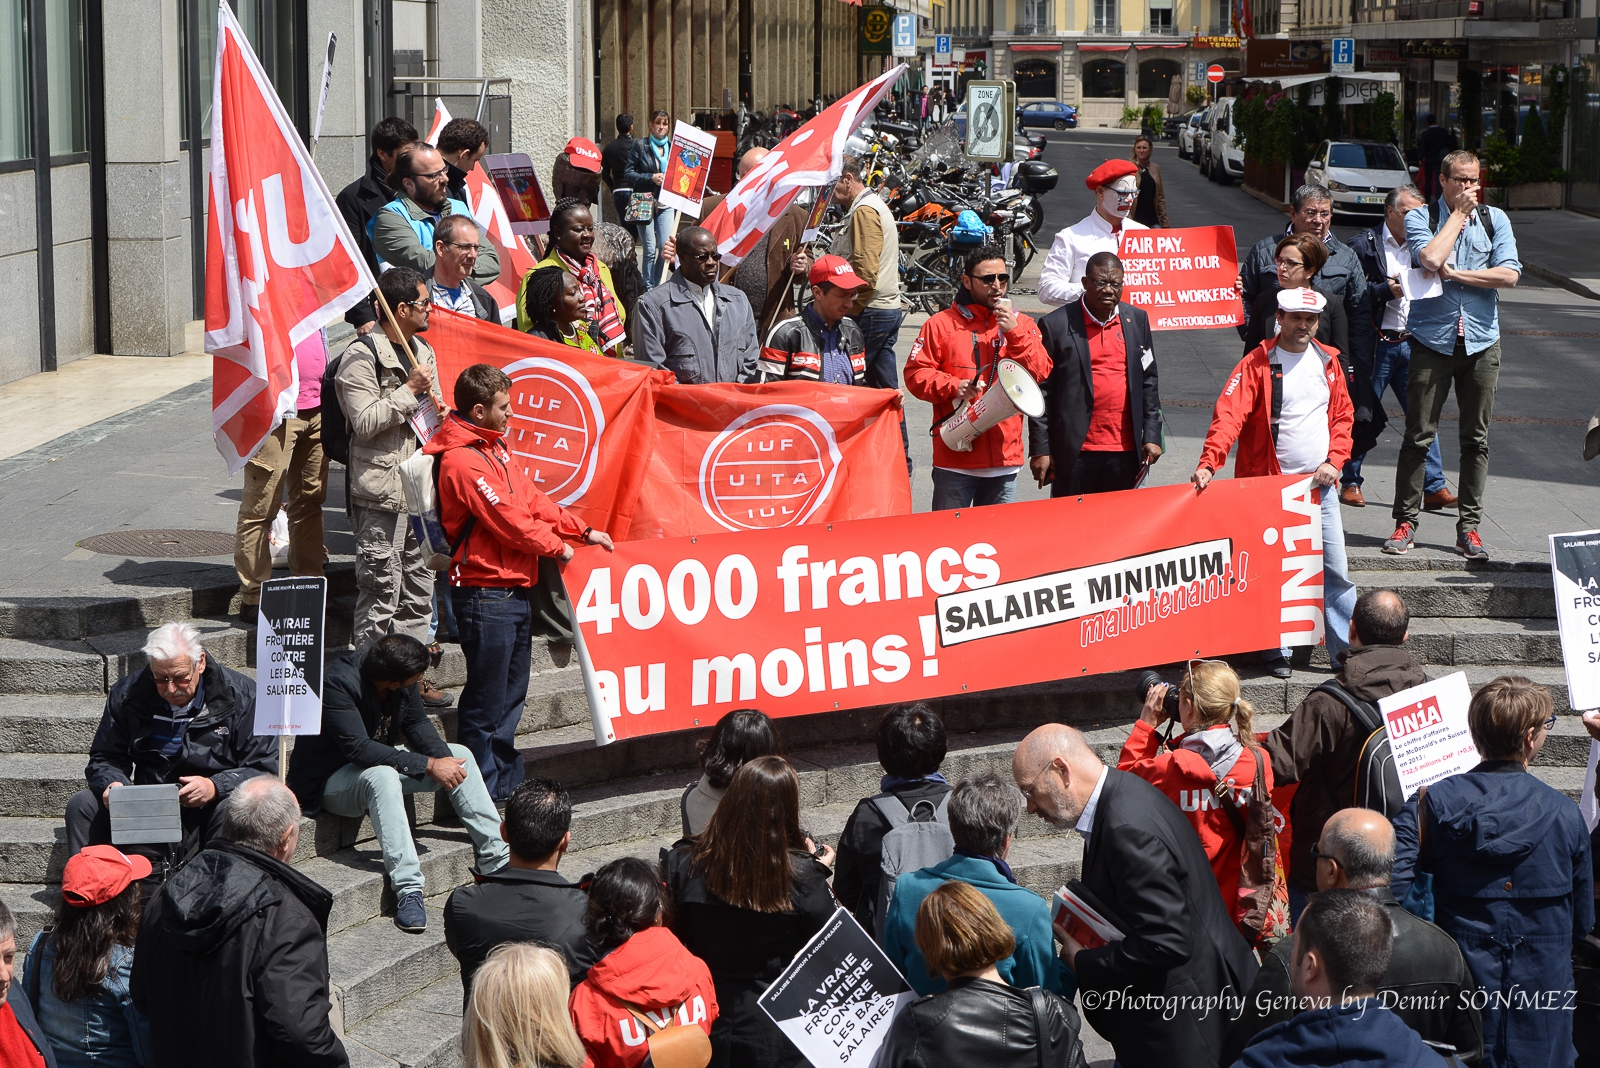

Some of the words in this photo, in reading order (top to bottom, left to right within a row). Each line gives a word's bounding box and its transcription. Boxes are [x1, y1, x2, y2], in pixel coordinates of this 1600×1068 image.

[899, 16, 910, 32] P
[1340, 41, 1348, 53] P
[977, 90, 993, 99] ZONE
[1124, 237, 1154, 254] FAIR
[1156, 237, 1186, 253] PAY.
[1120, 258, 1166, 272] RESPECT
[1169, 257, 1193, 271] FOR
[1194, 255, 1220, 270] OUR
[1122, 272, 1164, 286] RIGHTS.
[1129, 291, 1153, 305] FOR
[1154, 290, 1176, 305] ALL
[1176, 287, 1240, 303] WORKERS.
[1156, 314, 1239, 328] #FASTFOODGLOBAL
[517, 392, 562, 411] IUF
[747, 439, 794, 453] IUF
[729, 473, 808, 487] UITA
[748, 505, 795, 519] IUL
[1562, 541, 1586, 549] SALAIRE
[575, 553, 759, 635] 4000
[776, 542, 1001, 613] francs
[1577, 576, 1599, 590] LA
[945, 582, 1076, 634] SALAIRE
[1087, 551, 1224, 605] MINIMUM
[270, 618, 281, 630] LA
[1587, 614, 1600, 626] C
[1590, 632, 1600, 645] L
[270, 668, 283, 680] LES
[283, 667, 305, 679] BAS
[266, 684, 307, 696] SALAIRES
[594, 662, 666, 720] au
[1394, 743, 1403, 751] Le
[1403, 735, 1422, 749] chiffre
[1422, 726, 1450, 740] d'affaires
[1397, 752, 1405, 760] de
[1405, 739, 1438, 756] McDonald's
[1447, 729, 1468, 741] Suisse
[1401, 765, 1419, 777] 732,5
[1419, 756, 1442, 770] millions
[1442, 752, 1454, 761] CHF
[1408, 754, 1423, 765] 2013
[1405, 768, 1453, 790] Investissements
[1453, 765, 1462, 773] en
[770, 978, 791, 1002] SALAIRE
[789, 957, 809, 982] MINIMUM
[811, 939, 826, 955] 4000
[823, 919, 843, 942] FRANCS
[798, 997, 819, 1018] LA
[816, 952, 858, 995] VRAIE
[804, 957, 874, 1036] FRONTIÈRE
[823, 978, 874, 1035] CONTRE
[832, 1020, 856, 1048] LES
[854, 990, 882, 1020] BAS
[839, 997, 896, 1064] SALAIRES
